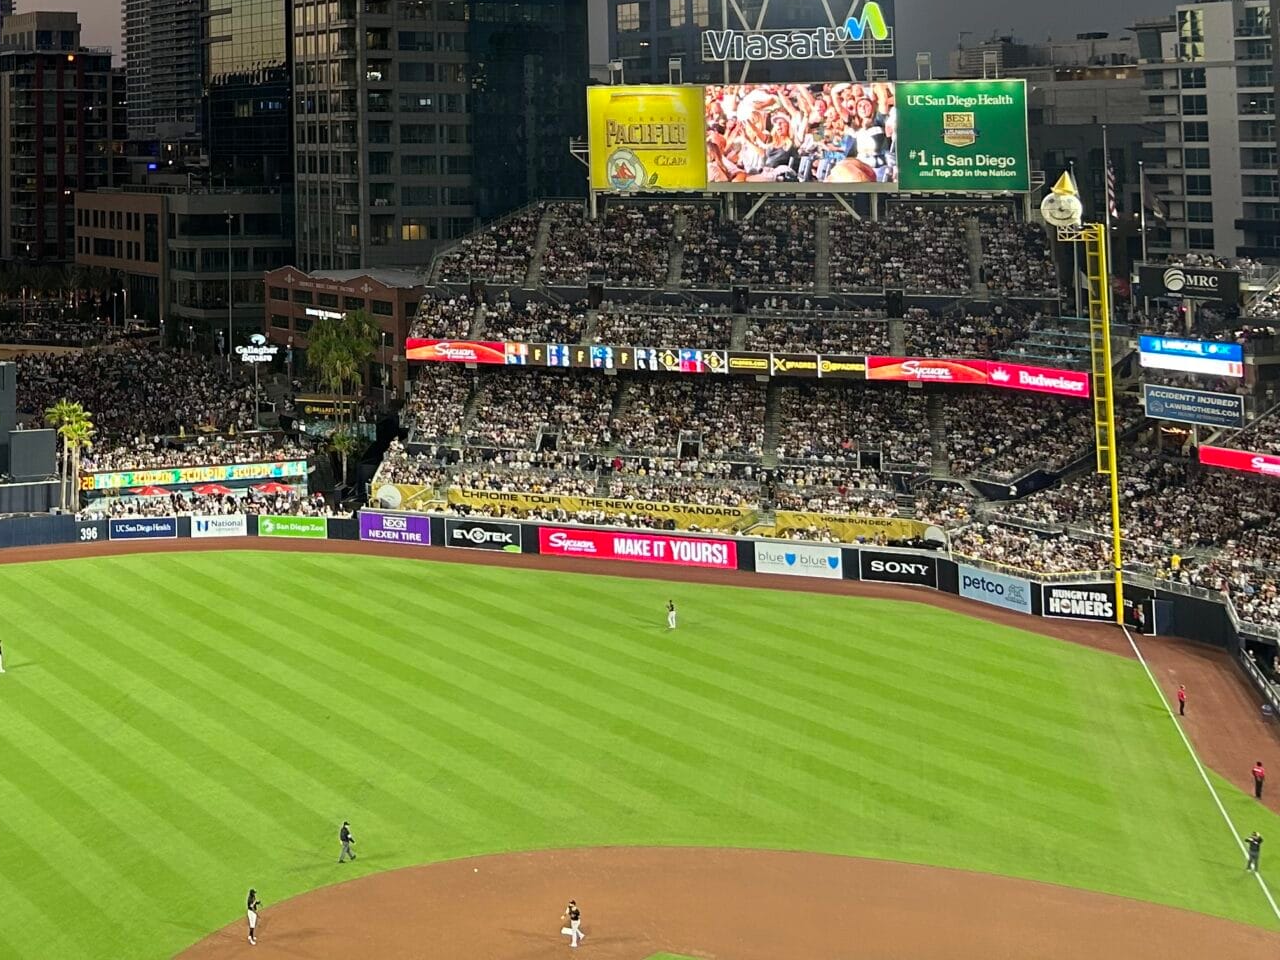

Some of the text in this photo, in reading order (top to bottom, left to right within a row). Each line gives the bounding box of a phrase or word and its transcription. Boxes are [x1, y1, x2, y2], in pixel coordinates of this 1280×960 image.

[706, 27, 835, 61] Viasat
[907, 94, 1014, 107] UC San Diego Health
[946, 114, 972, 123] BEST
[909, 149, 1016, 168] #1 in San Diego
[919, 169, 1016, 178] and Top 20 in the Nation
[1185, 275, 1219, 288] MRC
[235, 345, 278, 355] Gallagher
[434, 343, 477, 359] Sycuan
[534, 349, 541, 360] F
[578, 351, 584, 362] F
[241, 354, 273, 363] Square
[622, 352, 628, 364] F
[900, 360, 950, 379] Sycuan
[1019, 371, 1084, 390] Budweiser
[1148, 390, 1240, 408] ACCIDENT? INJURED?
[1165, 401, 1240, 418] LAWBROTHERS.COM
[462, 491, 518, 502] CHROME
[523, 495, 561, 505] TOUR
[580, 498, 602, 508] THE
[606, 500, 634, 510] NEW
[636, 502, 671, 512] GOLD
[115, 523, 172, 533] UC San Diego Health
[211, 519, 238, 528] National
[290, 524, 309, 532] Diego
[869, 519, 893, 527] DECK
[80, 527, 98, 541] 396
[368, 529, 422, 541] NEXEN TIRE
[549, 533, 595, 551] Sycuan
[613, 538, 728, 565] MAKE IT YOURS!
[758, 552, 827, 566] blue blue
[870, 560, 929, 577] SONY
[963, 573, 1005, 596] petco
[1051, 588, 1088, 602] HUNGRY
[1089, 591, 1108, 603] FOR
[1049, 598, 1114, 618] HOMERS
